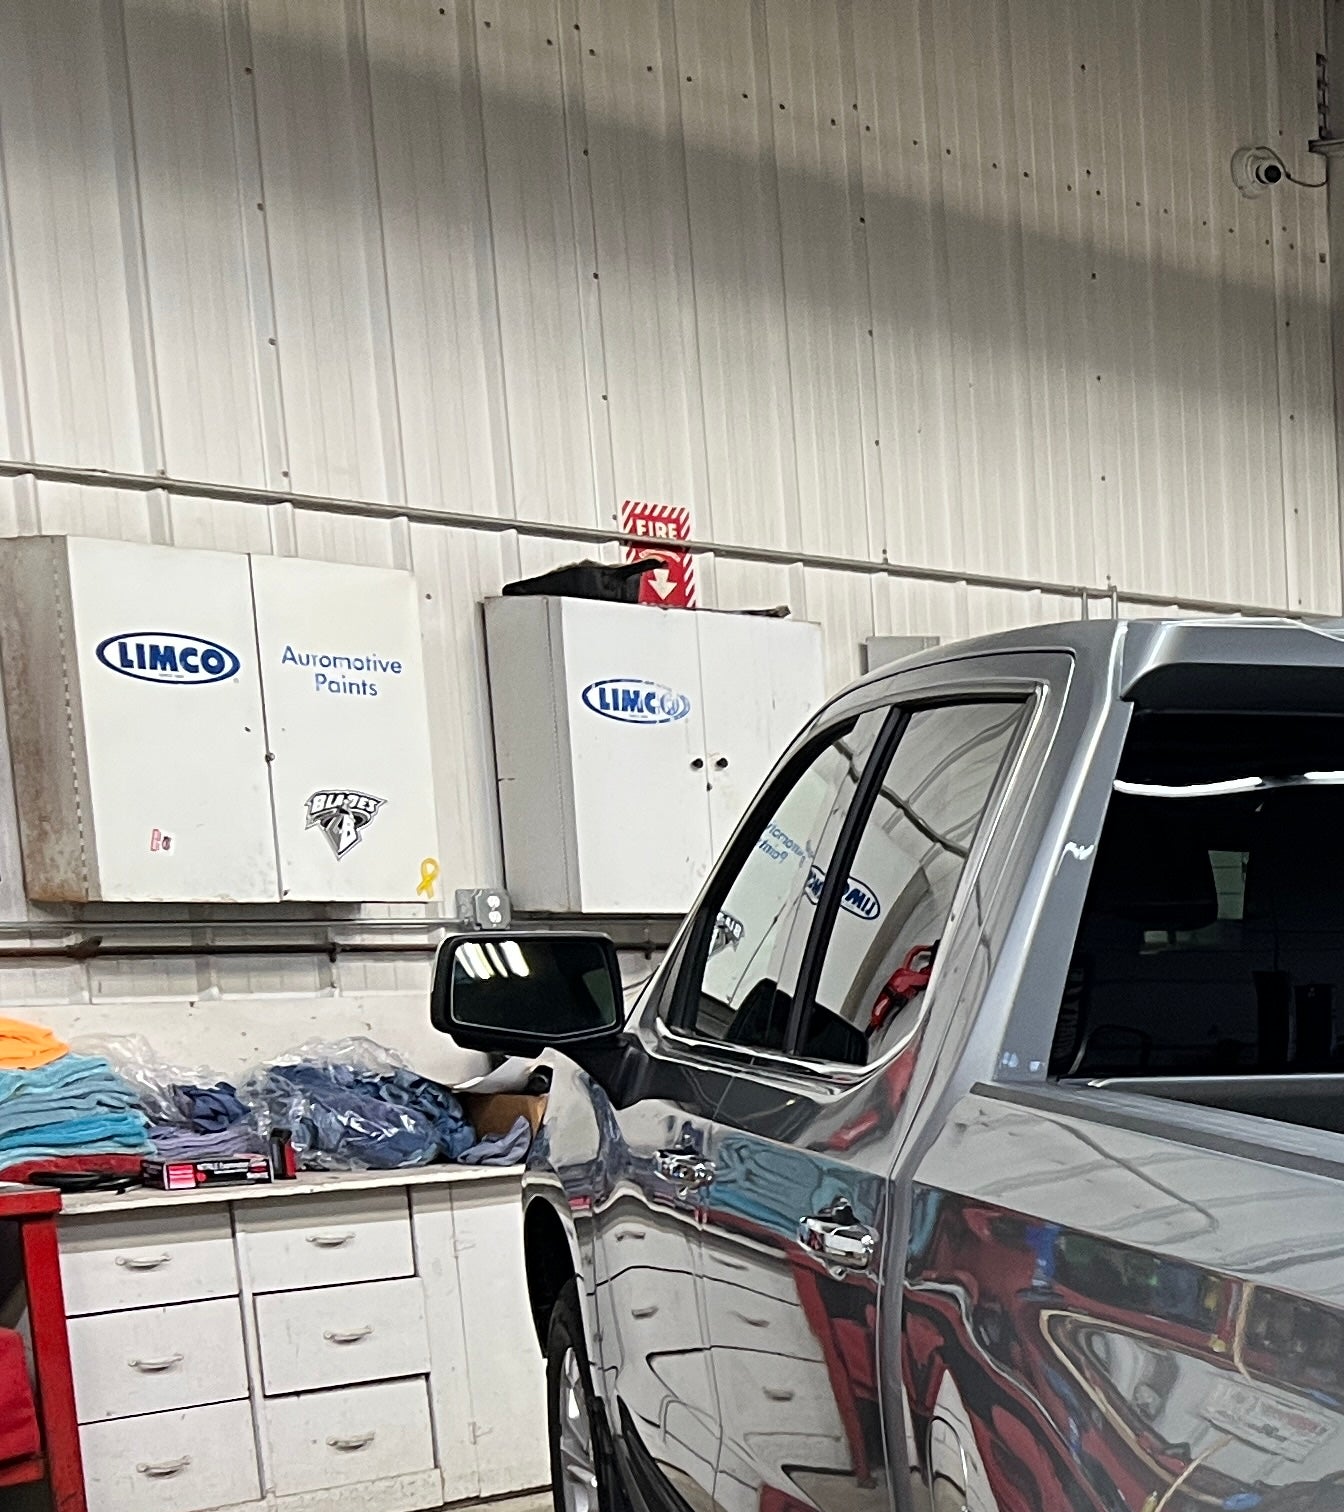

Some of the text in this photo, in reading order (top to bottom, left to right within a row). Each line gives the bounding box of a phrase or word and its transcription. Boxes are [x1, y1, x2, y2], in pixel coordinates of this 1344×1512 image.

[636, 519, 678, 540] FIRE
[117, 641, 226, 676] LIMCO
[315, 673, 378, 697] Paints
[598, 687, 681, 717] LIMCO
